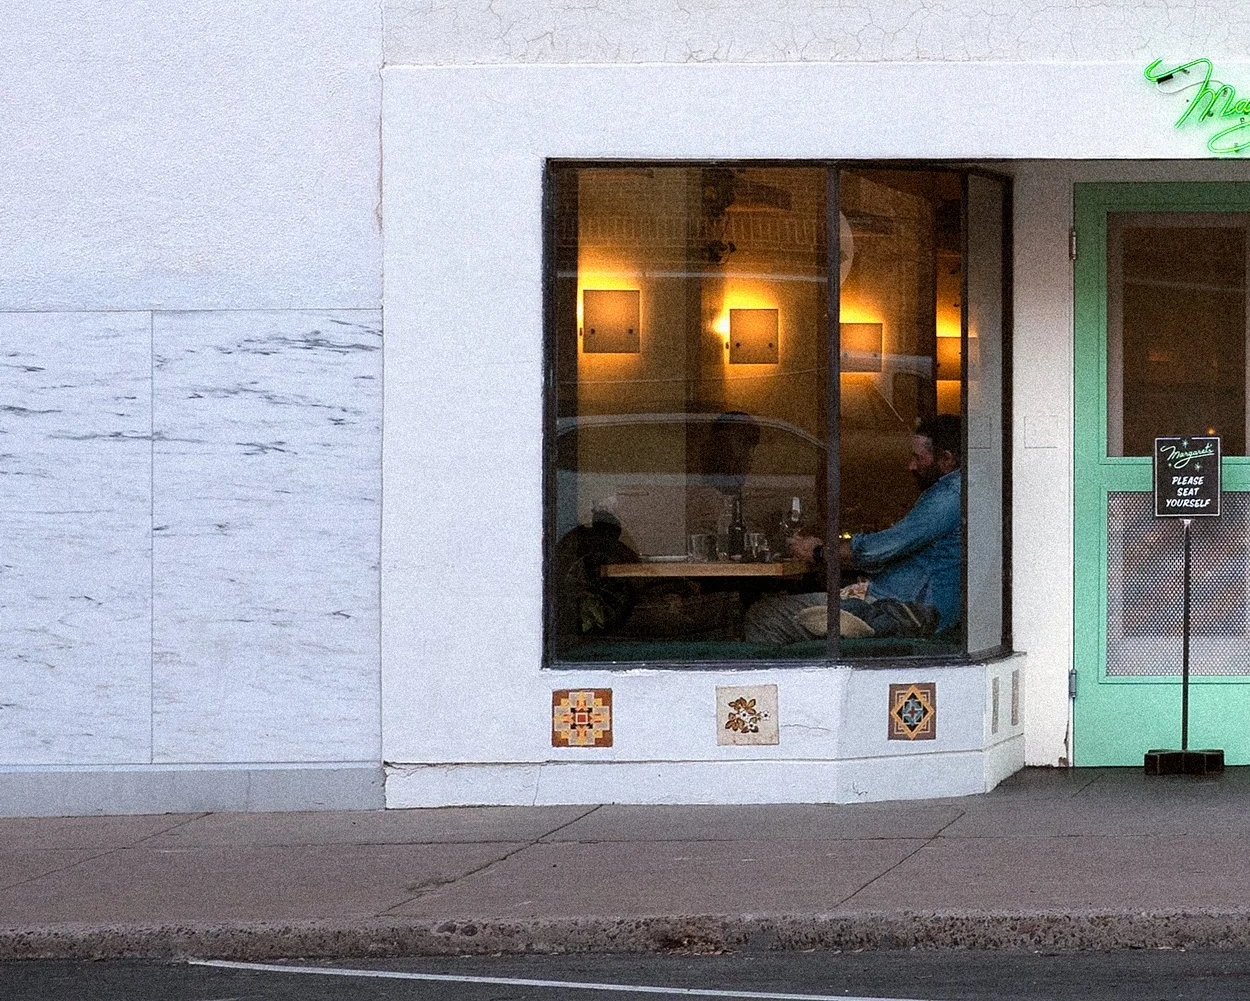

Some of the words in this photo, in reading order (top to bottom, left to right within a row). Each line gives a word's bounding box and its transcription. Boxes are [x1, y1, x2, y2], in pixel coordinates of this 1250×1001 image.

[1171, 476, 1205, 486] PLEASE
[1177, 487, 1200, 497] SEAT
[1166, 498, 1211, 508] YOURSELF
